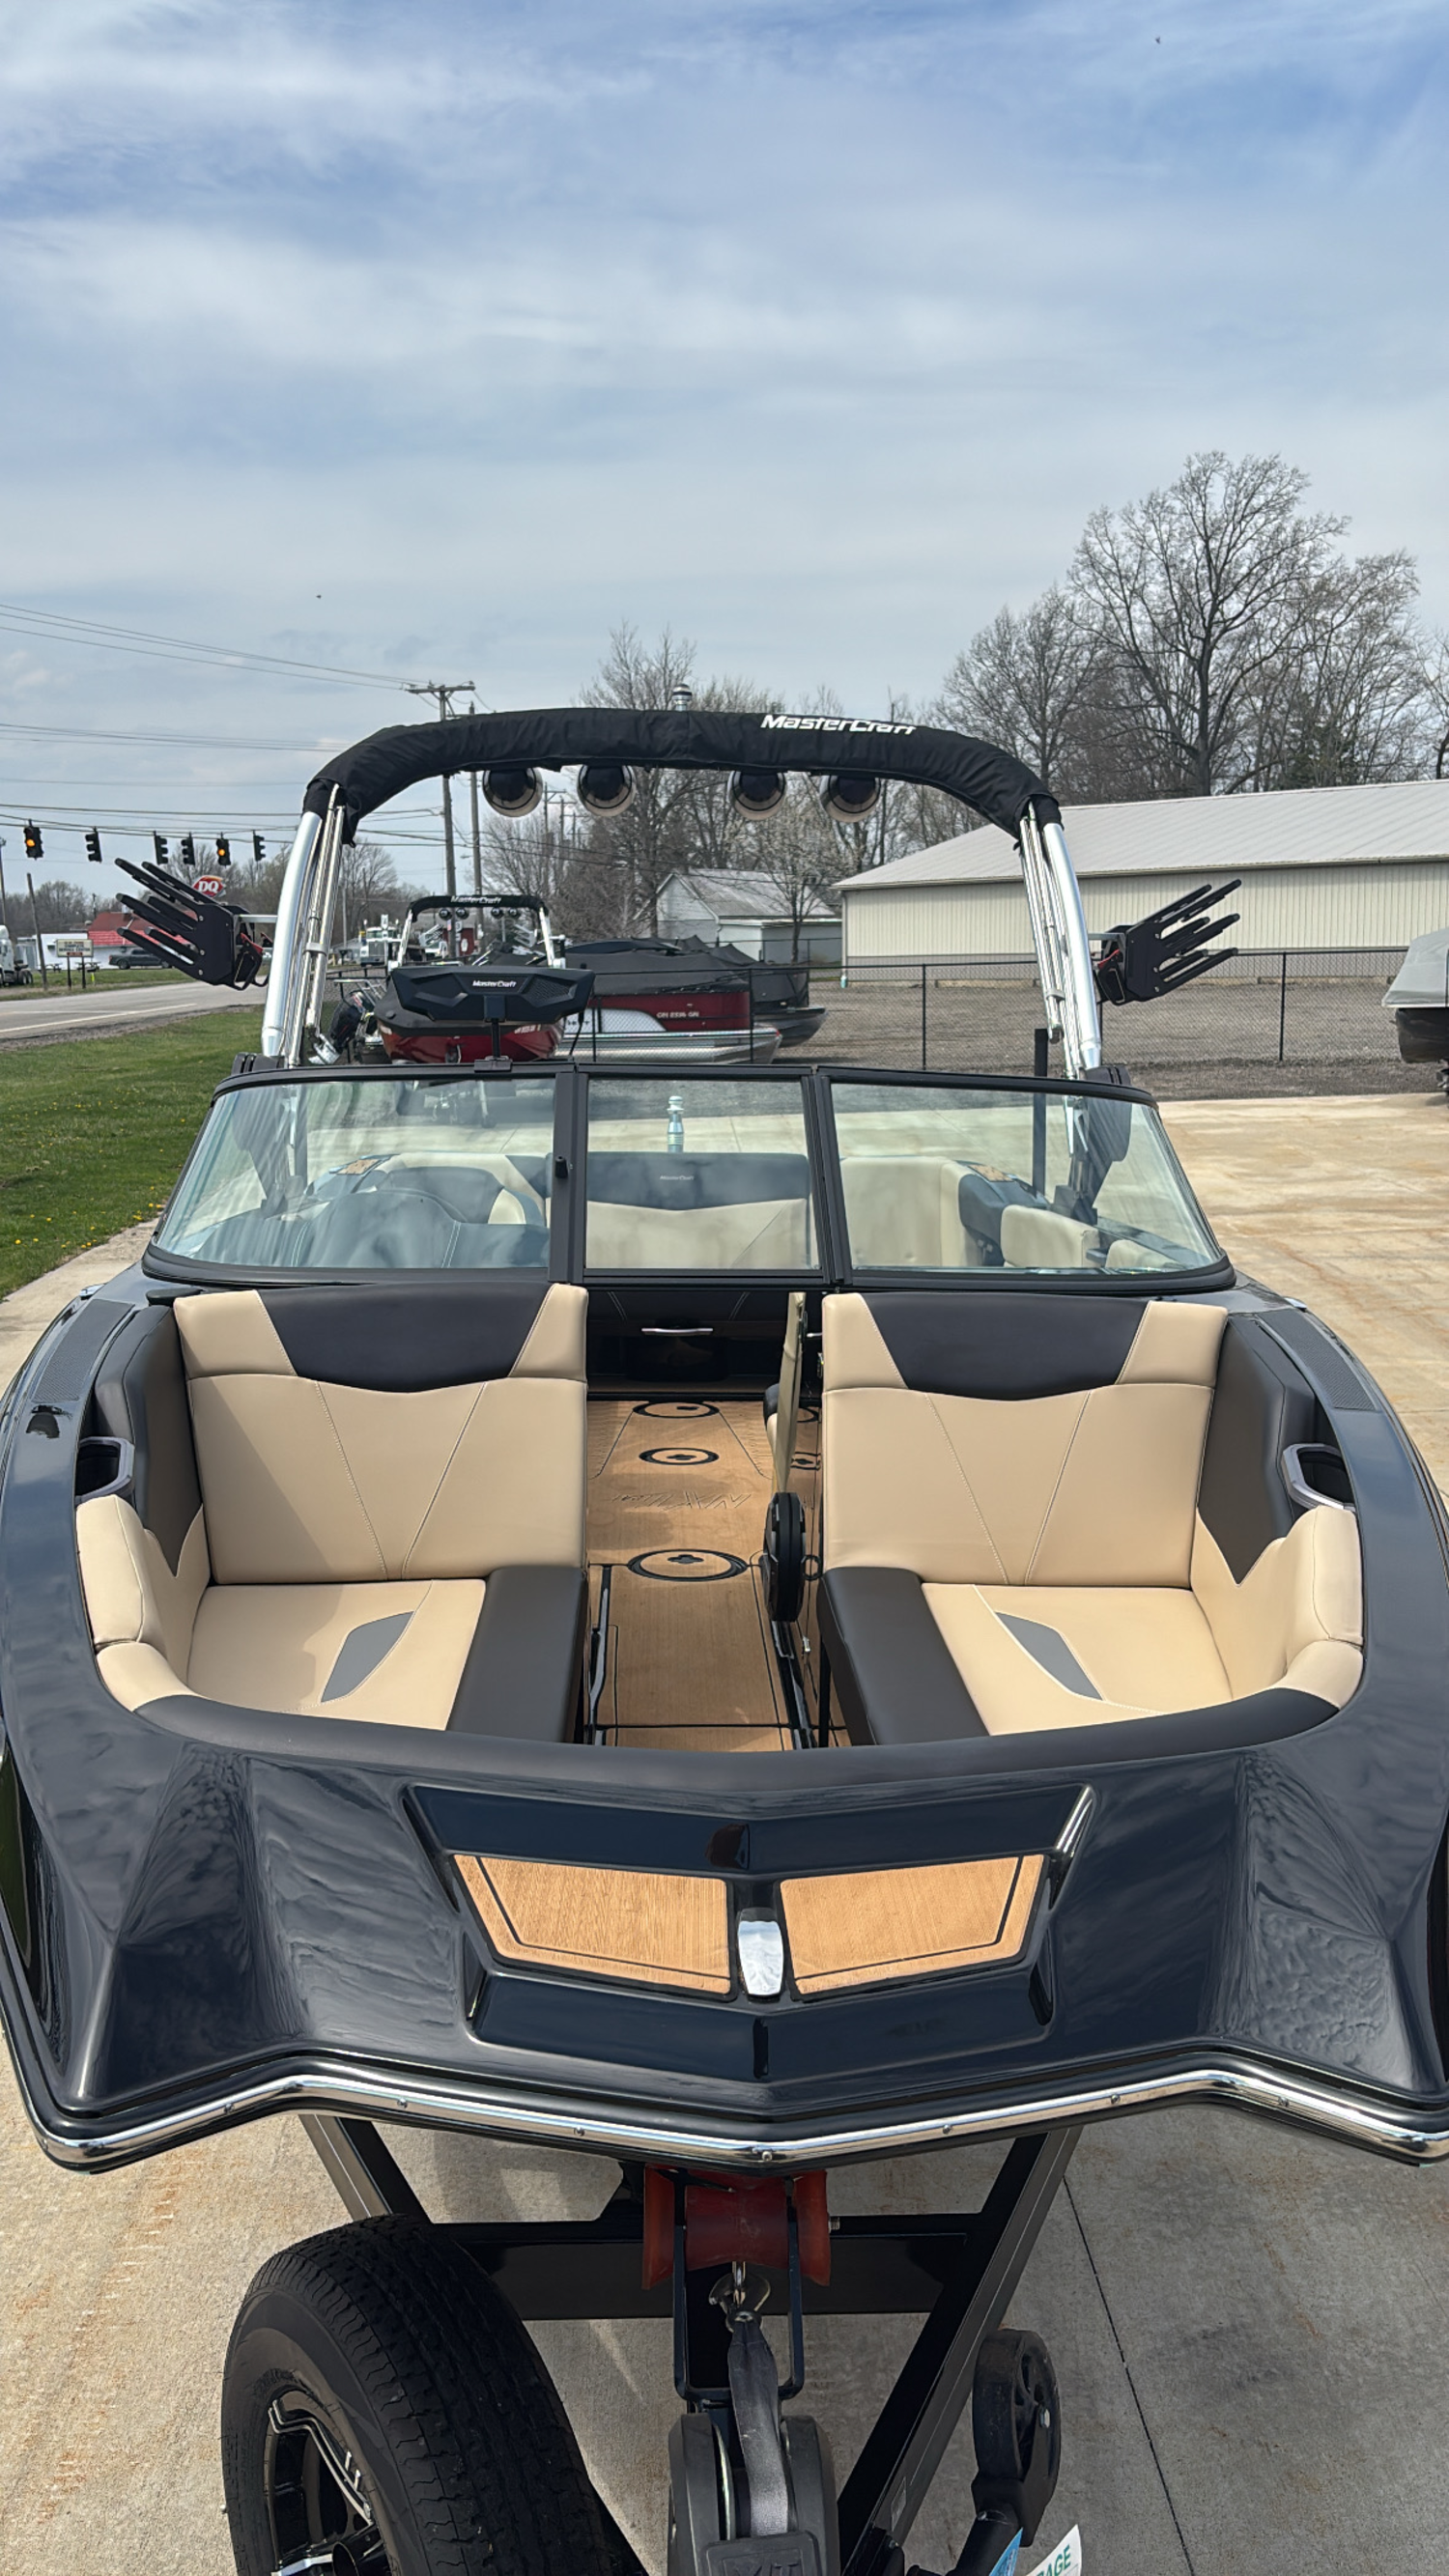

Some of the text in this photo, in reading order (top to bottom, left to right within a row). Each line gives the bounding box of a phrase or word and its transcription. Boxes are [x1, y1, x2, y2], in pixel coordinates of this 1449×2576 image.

[759, 714, 917, 735] MasterCraft
[198, 880, 219, 894] DQ
[472, 979, 517, 988] MasterCraft
[1037, 2544, 1070, 2576] AGE
